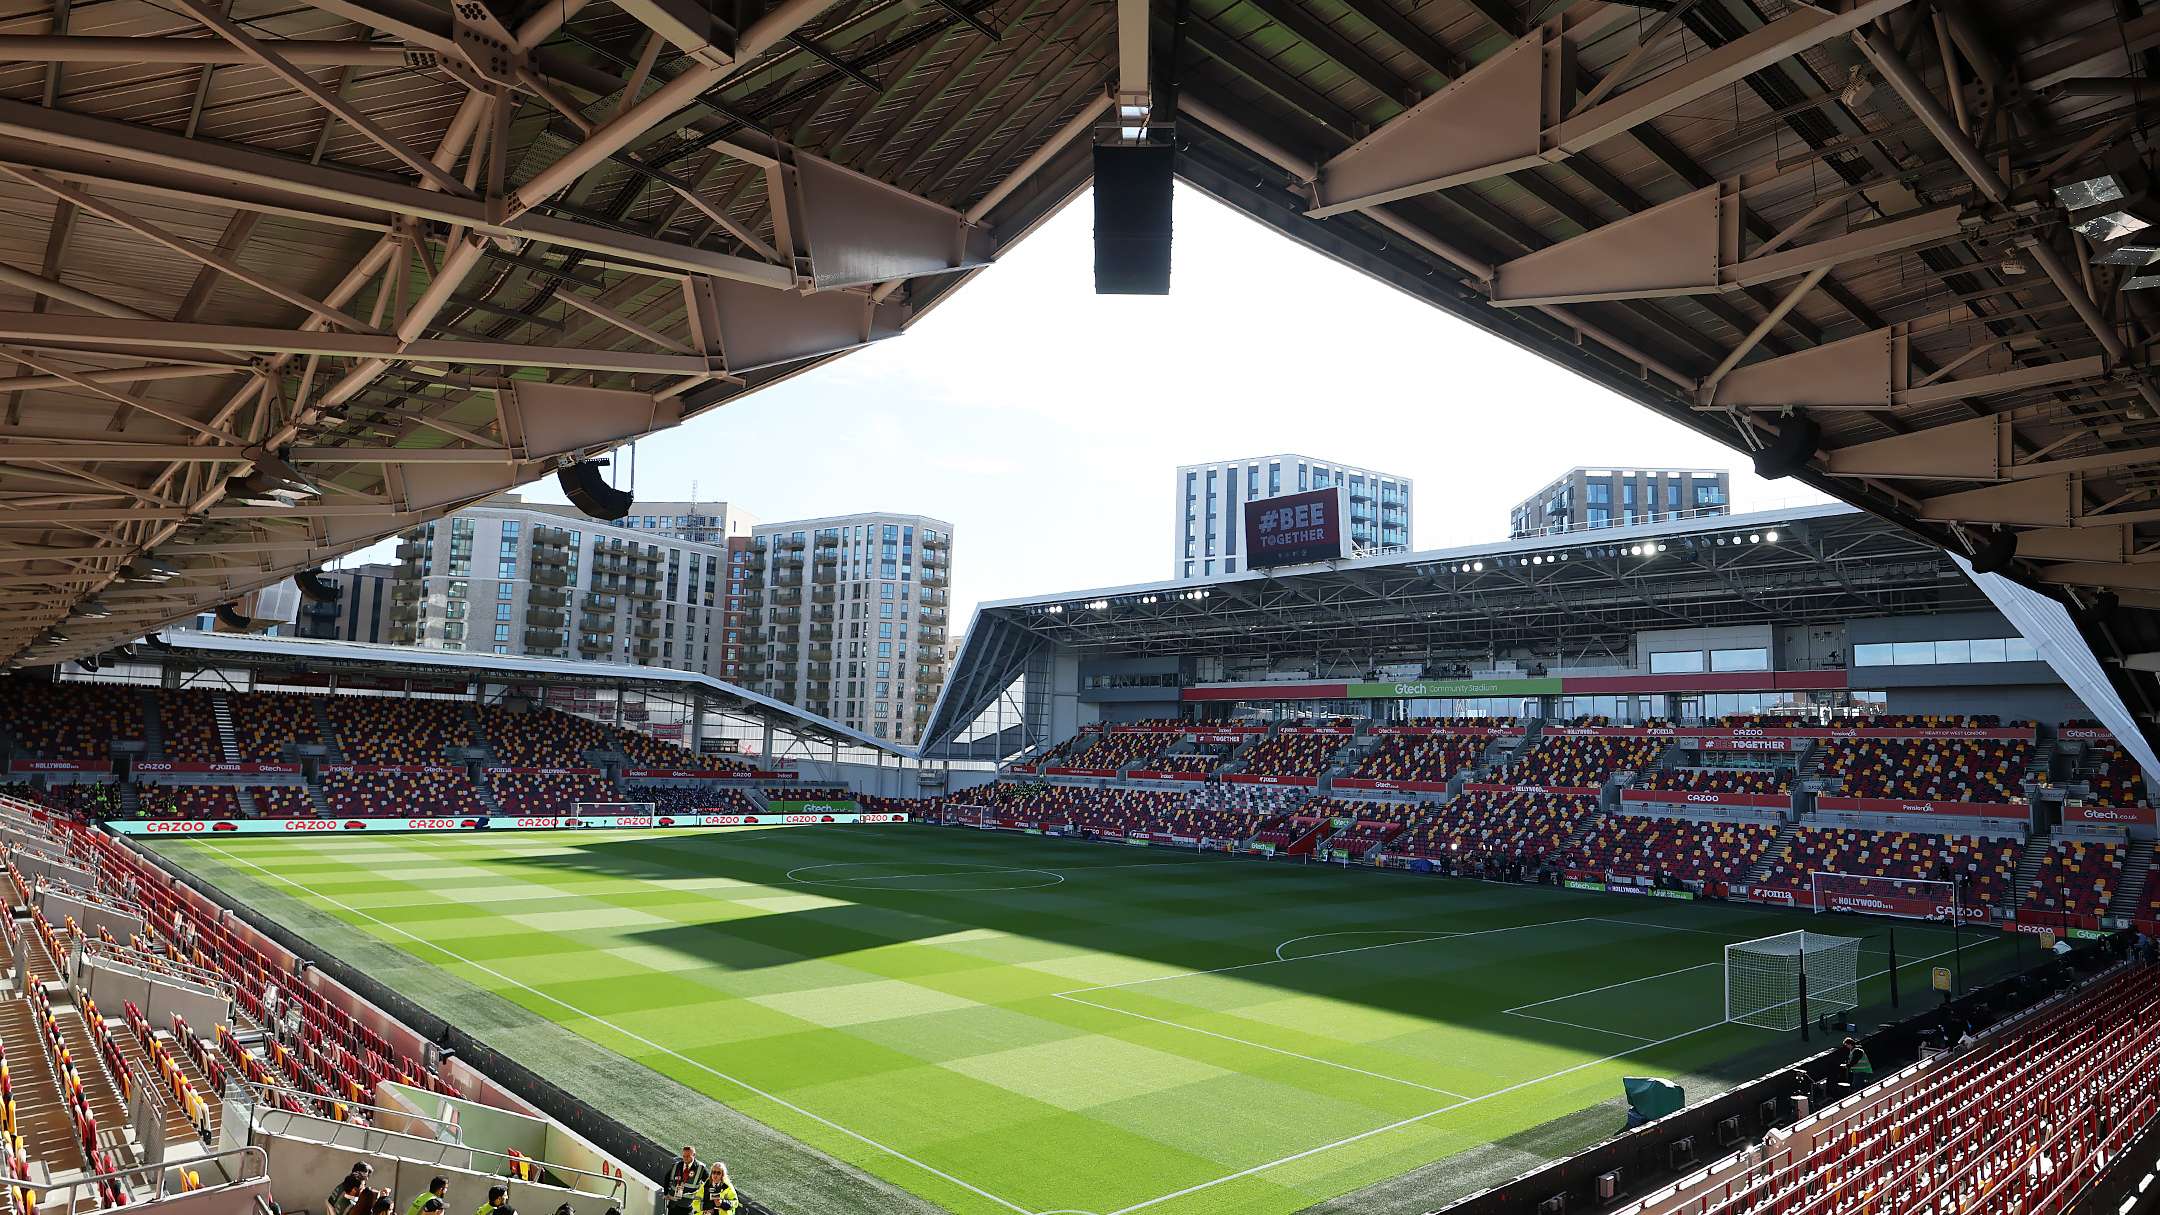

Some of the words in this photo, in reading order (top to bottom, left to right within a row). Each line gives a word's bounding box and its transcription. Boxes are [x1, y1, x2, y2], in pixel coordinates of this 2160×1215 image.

[1259, 502, 1324, 534] #BEE
[1260, 529, 1325, 546] TOGETHER
[1395, 684, 1427, 695] Gtech
[1430, 686, 1468, 696] Community
[1469, 684, 1498, 694] Stadium
[1687, 794, 1719, 802] CAZOO
[517, 818, 559, 827] CAZOO
[616, 817, 652, 825] CAZOO
[705, 816, 740, 824] CAZOO
[786, 815, 817, 823] CAZOO
[861, 814, 887, 822] AZOO
[146, 822, 205, 832] CAZOO
[285, 820, 337, 830] CAZOO
[408, 819, 454, 829] CAZOO
[1762, 889, 1793, 901] Joma
[2017, 925, 2054, 935] CAZOO
